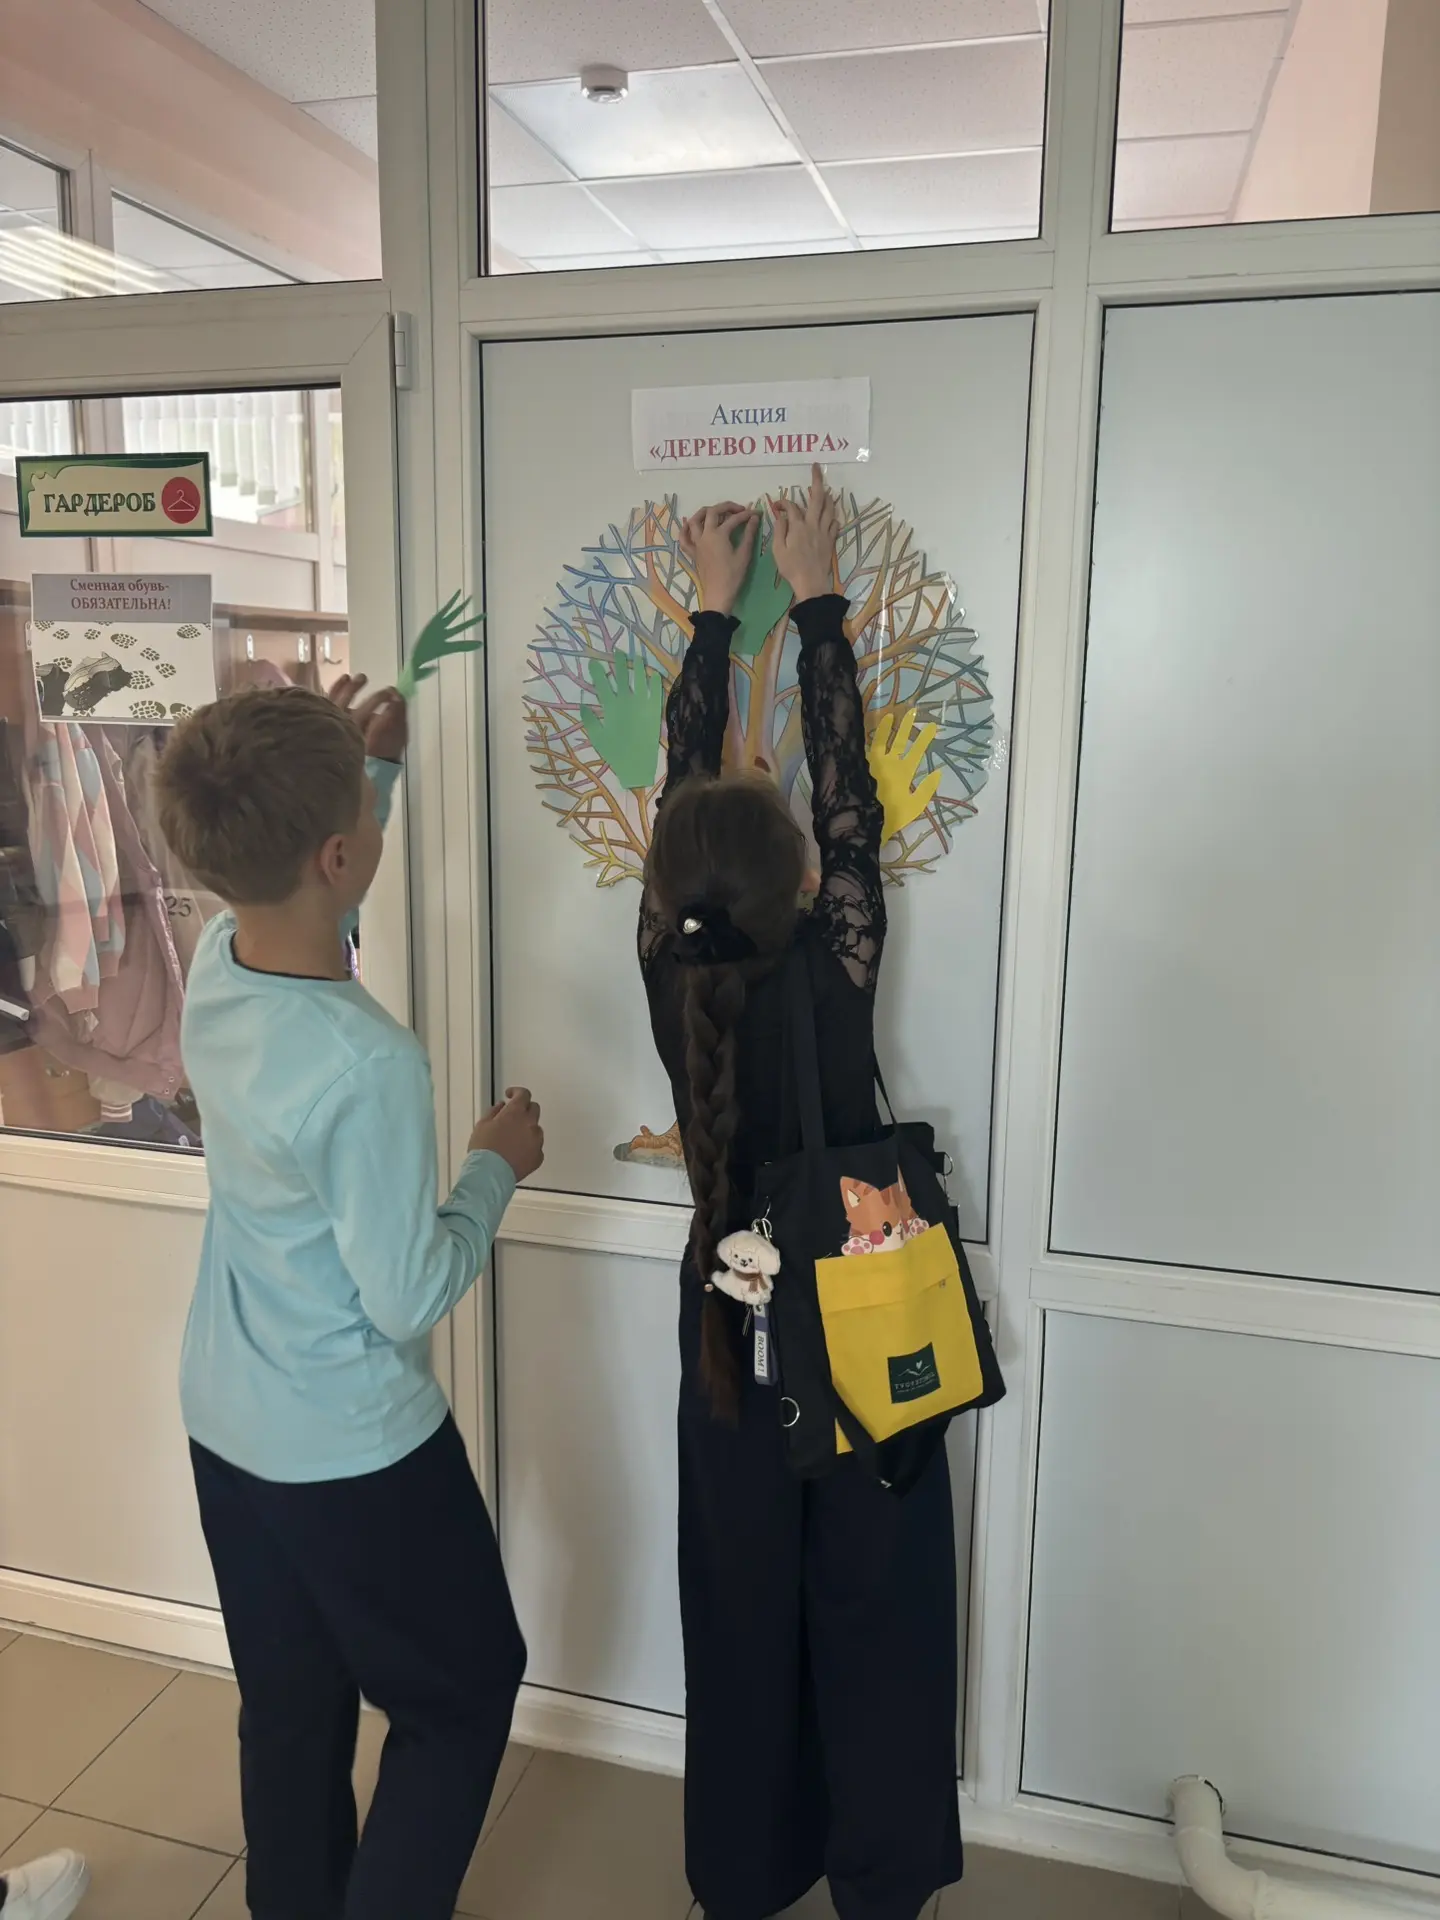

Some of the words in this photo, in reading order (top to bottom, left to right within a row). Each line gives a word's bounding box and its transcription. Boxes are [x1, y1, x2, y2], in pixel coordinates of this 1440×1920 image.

[710, 404, 787, 426] Акция
[649, 435, 757, 463] «ДЕРЕВО
[763, 432, 850, 455] МИРА»
[43, 491, 156, 517] ГАРДЕРОБ
[70, 578, 125, 592] Сменная
[128, 579, 170, 595] обувь-
[71, 597, 171, 611] ОБЯЗАТЕЛЬНА!
